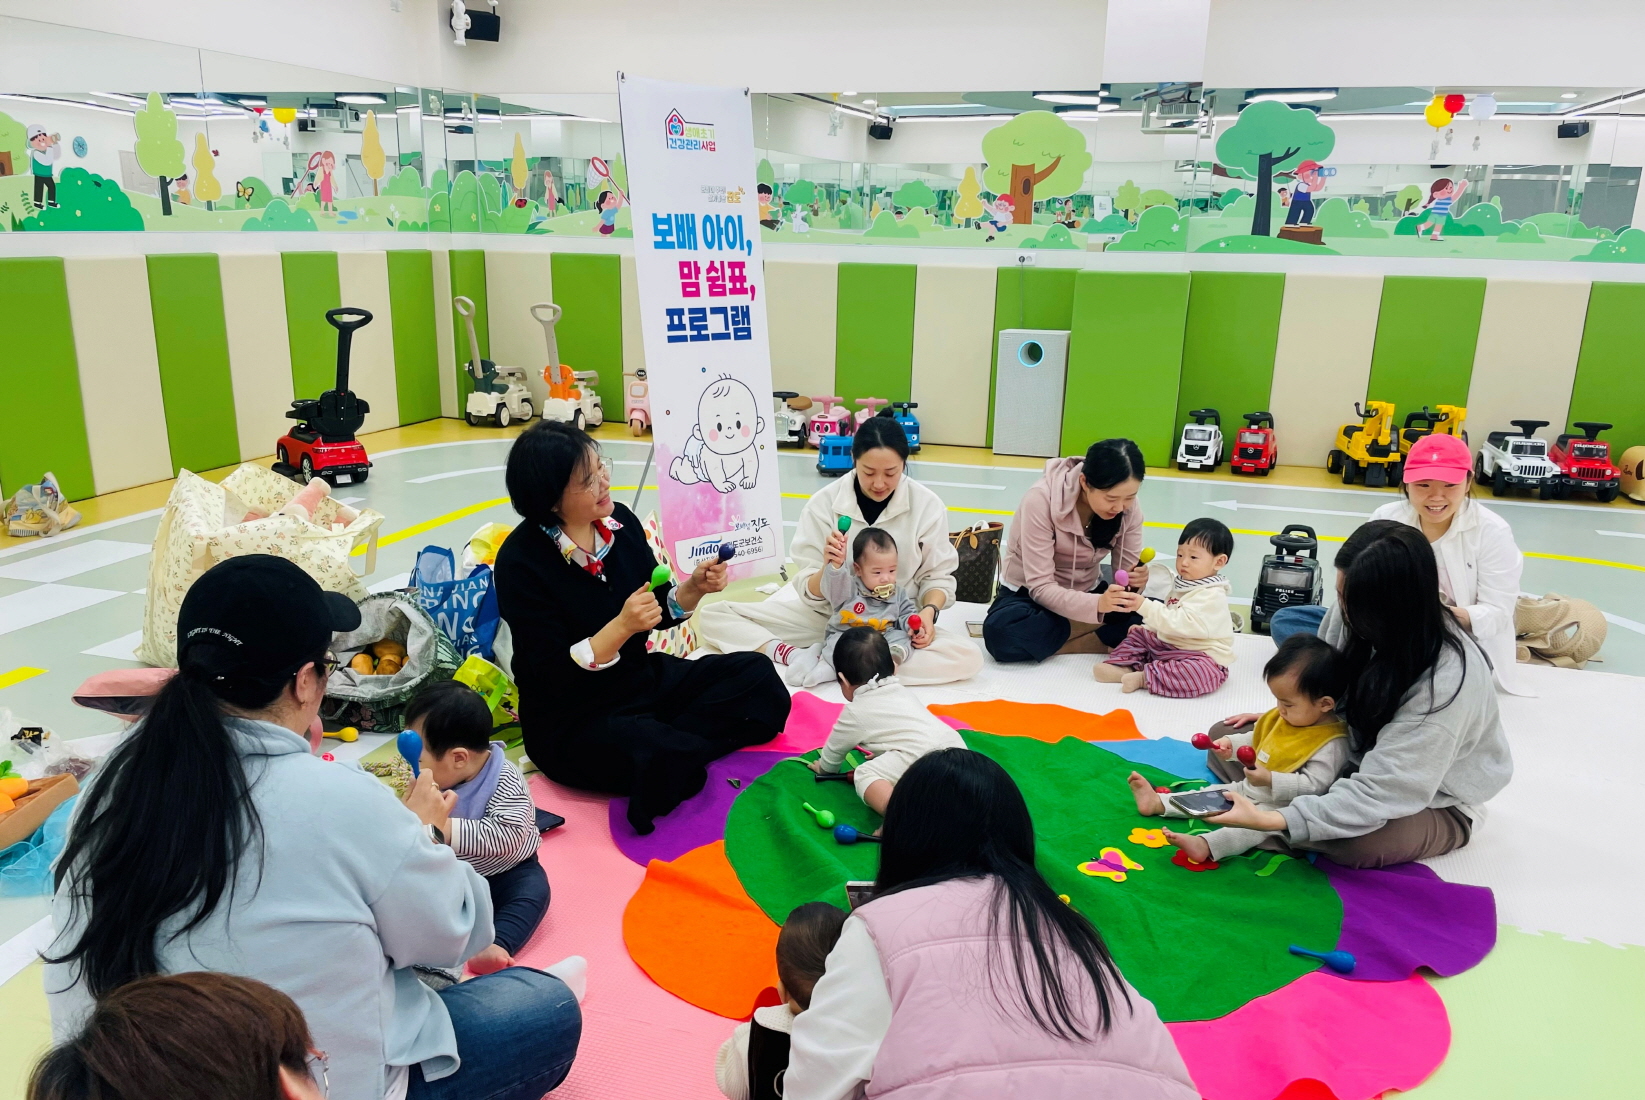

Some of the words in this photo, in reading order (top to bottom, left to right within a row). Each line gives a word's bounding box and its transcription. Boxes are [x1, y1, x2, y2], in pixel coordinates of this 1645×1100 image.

[685, 127, 715, 139] 생애초기
[652, 213, 698, 250] 보배
[702, 214, 752, 256] 아이,
[679, 260, 701, 297] 맘
[706, 260, 756, 301] 쉼표,
[666, 305, 752, 343] 프로그램
[751, 517, 770, 532] 진도
[688, 542, 719, 559] Jindo
